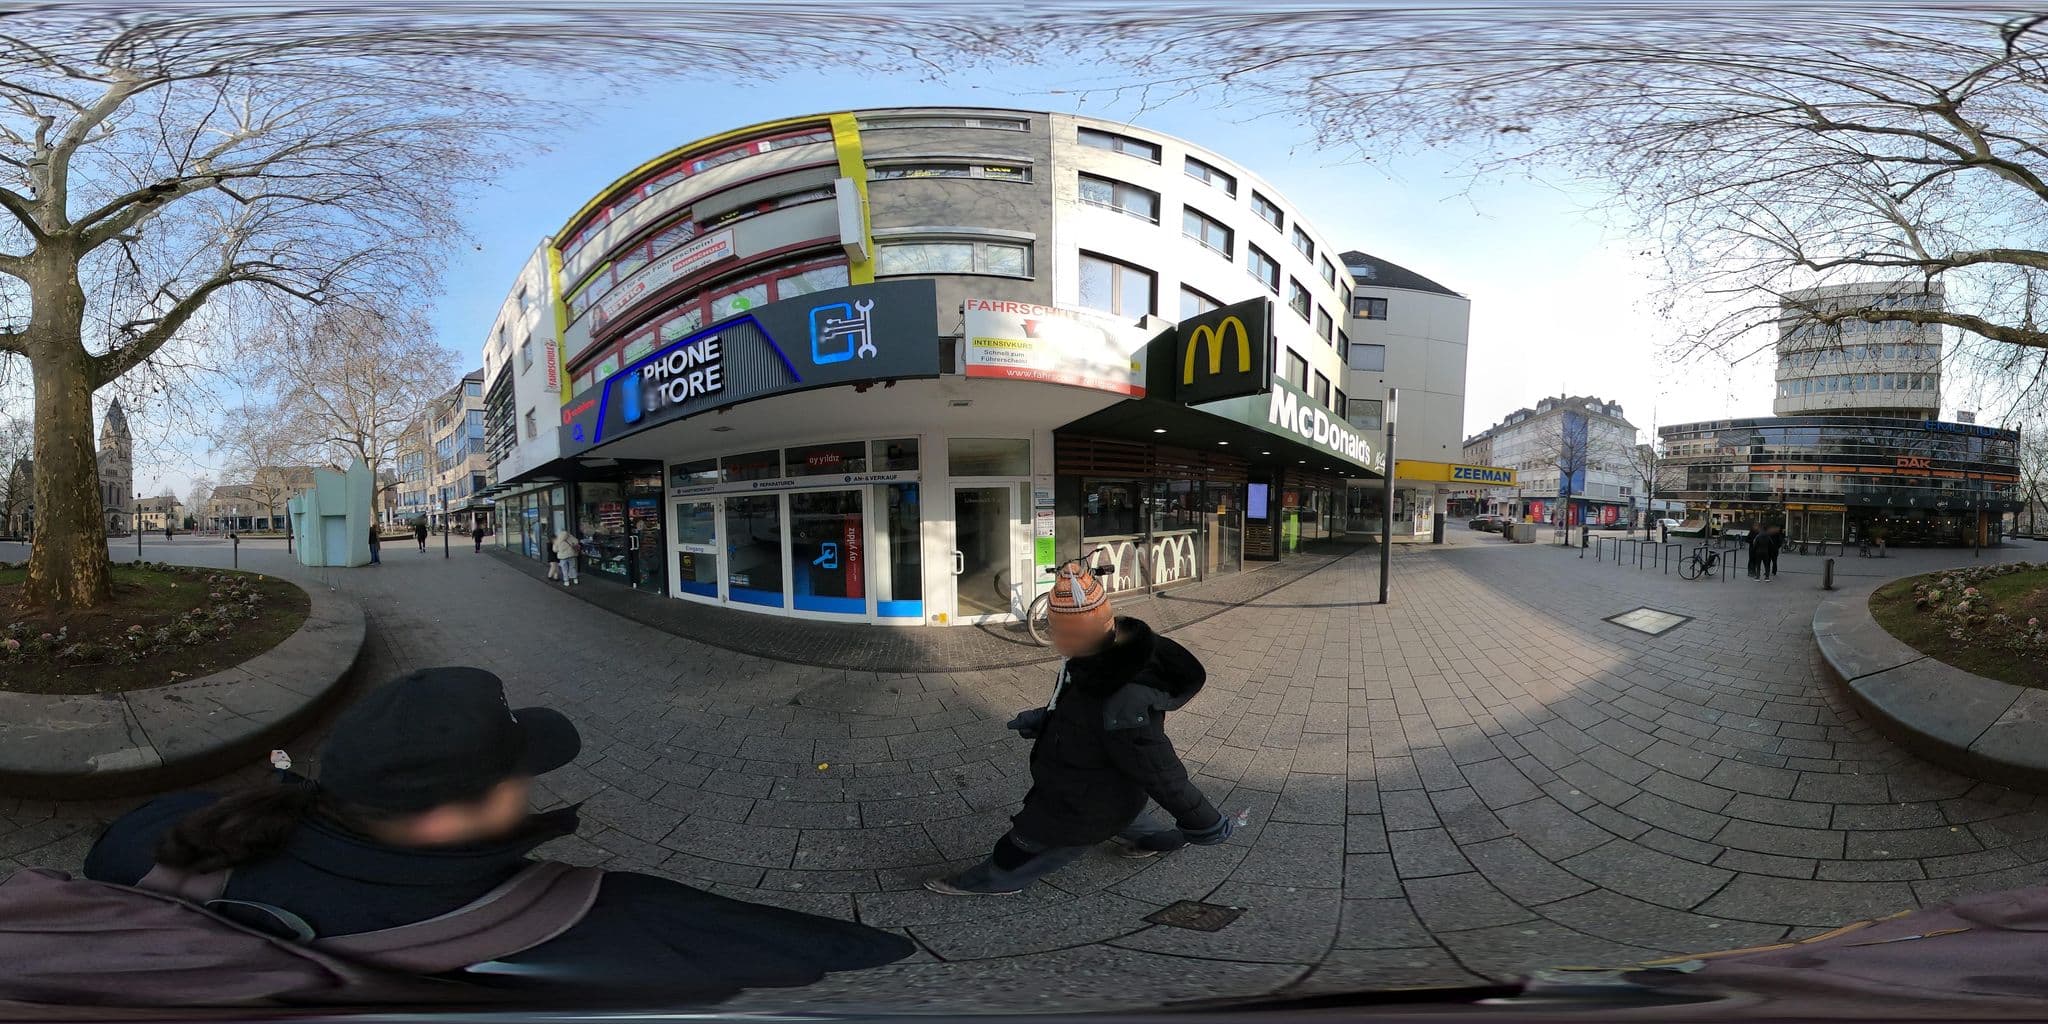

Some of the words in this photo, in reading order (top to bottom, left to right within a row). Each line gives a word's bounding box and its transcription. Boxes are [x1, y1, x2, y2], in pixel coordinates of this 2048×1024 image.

[652, 238, 714, 273] Führerschein!
[673, 242, 726, 270] FAHRSCHULE
[974, 339, 1033, 349] INTENSIVKURS
[643, 336, 721, 381] PHONE
[1269, 383, 1371, 465] McDonald's
[1454, 467, 1511, 482] ZEEMAN
[1896, 457, 1931, 468] DAK
